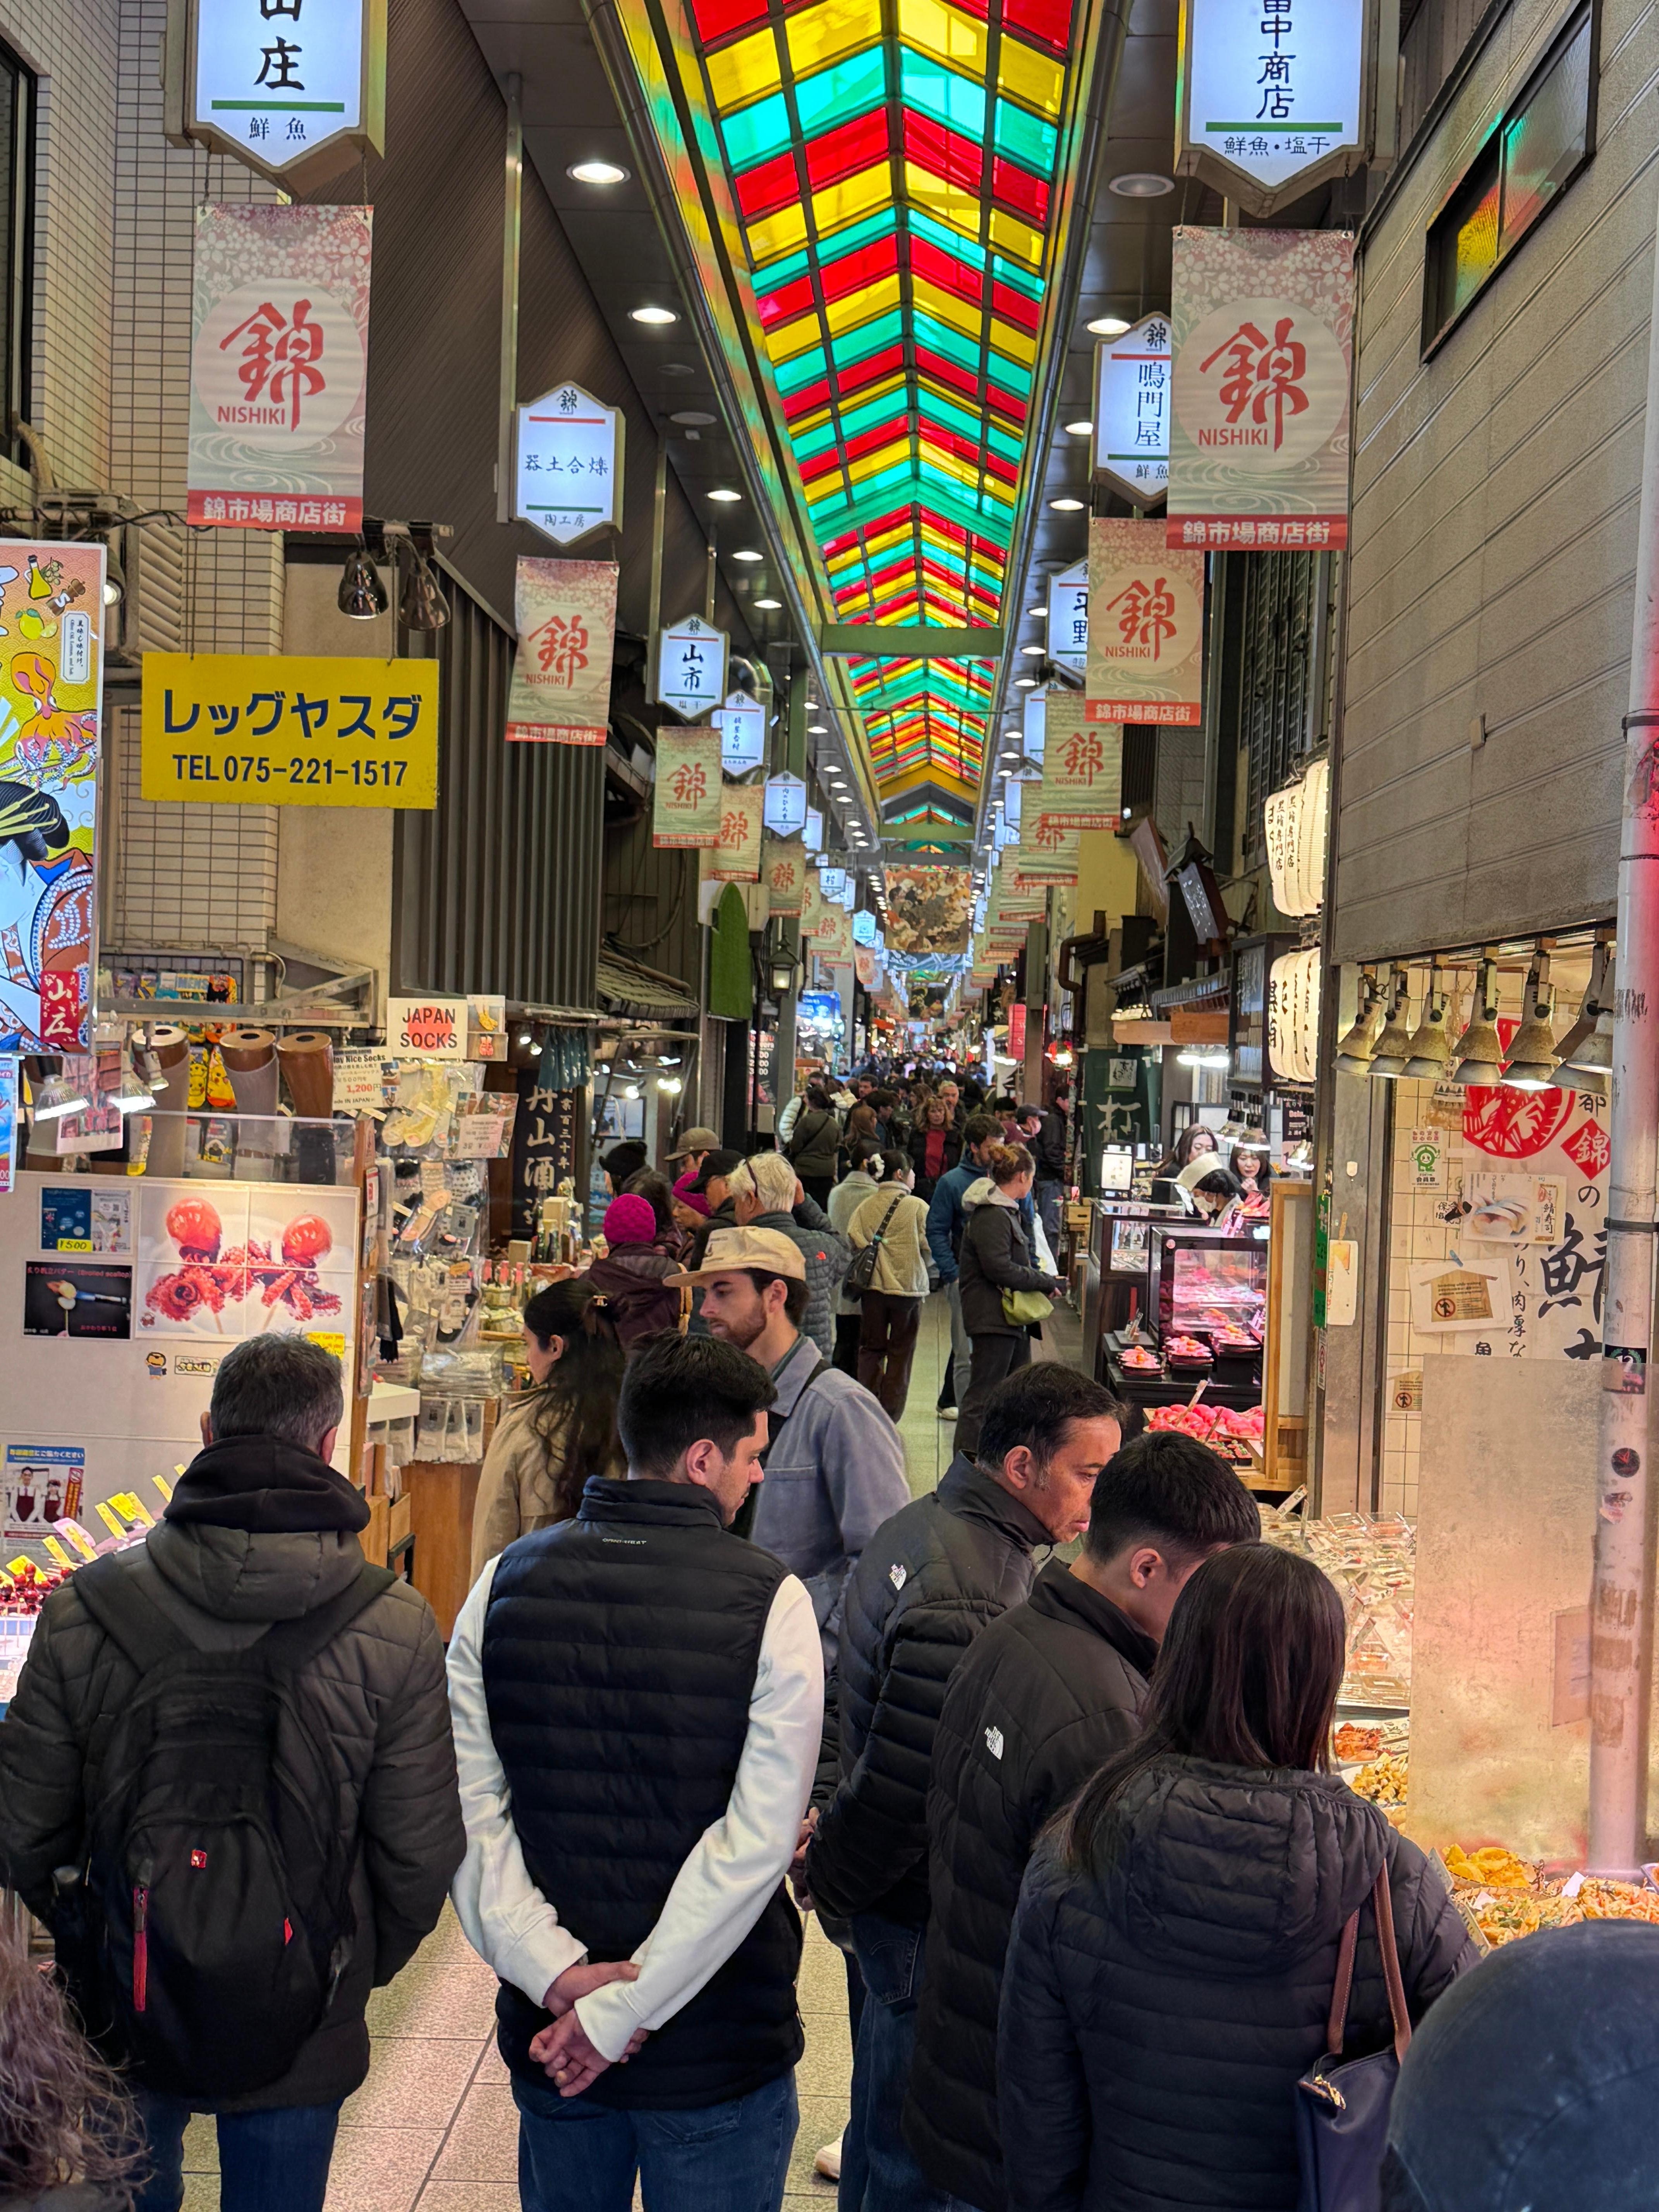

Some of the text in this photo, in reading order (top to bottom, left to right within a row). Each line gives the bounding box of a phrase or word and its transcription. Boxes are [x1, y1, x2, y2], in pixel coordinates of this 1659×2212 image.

[249, 117, 307, 140] 鮮魚
[1224, 136, 1330, 155] 鮮魚・塩干
[219, 299, 326, 432] 錦
[1200, 317, 1309, 452] 錦
[217, 406, 285, 425] NISHIKI
[1134, 362, 1164, 447] 鳴門屋
[1199, 428, 1267, 446] NISHIKI
[204, 496, 347, 526] 錦市場商店街
[544, 514, 585, 528] 陶工房
[1183, 520, 1330, 545] 錦市場商店街
[1106, 577, 1176, 662] 錦
[528, 615, 589, 689] 錦
[1106, 646, 1150, 658] NISHIKI
[526, 673, 565, 685] NISHIKI
[681, 644, 704, 690] 山市
[164, 689, 422, 740] レッグヤスダ
[1096, 704, 1190, 722] 錦市場商店街
[172, 754, 408, 787] TEL 075-221-1517
[1056, 731, 1104, 787] 錦
[667, 763, 706, 811] 錦
[1056, 777, 1086, 785] NISHIKI
[721, 811, 749, 851] 錦
[402, 1008, 456, 1024] JAPAN
[400, 1032, 458, 1048] SOCKS
[363, 1054, 386, 1062] Socks
